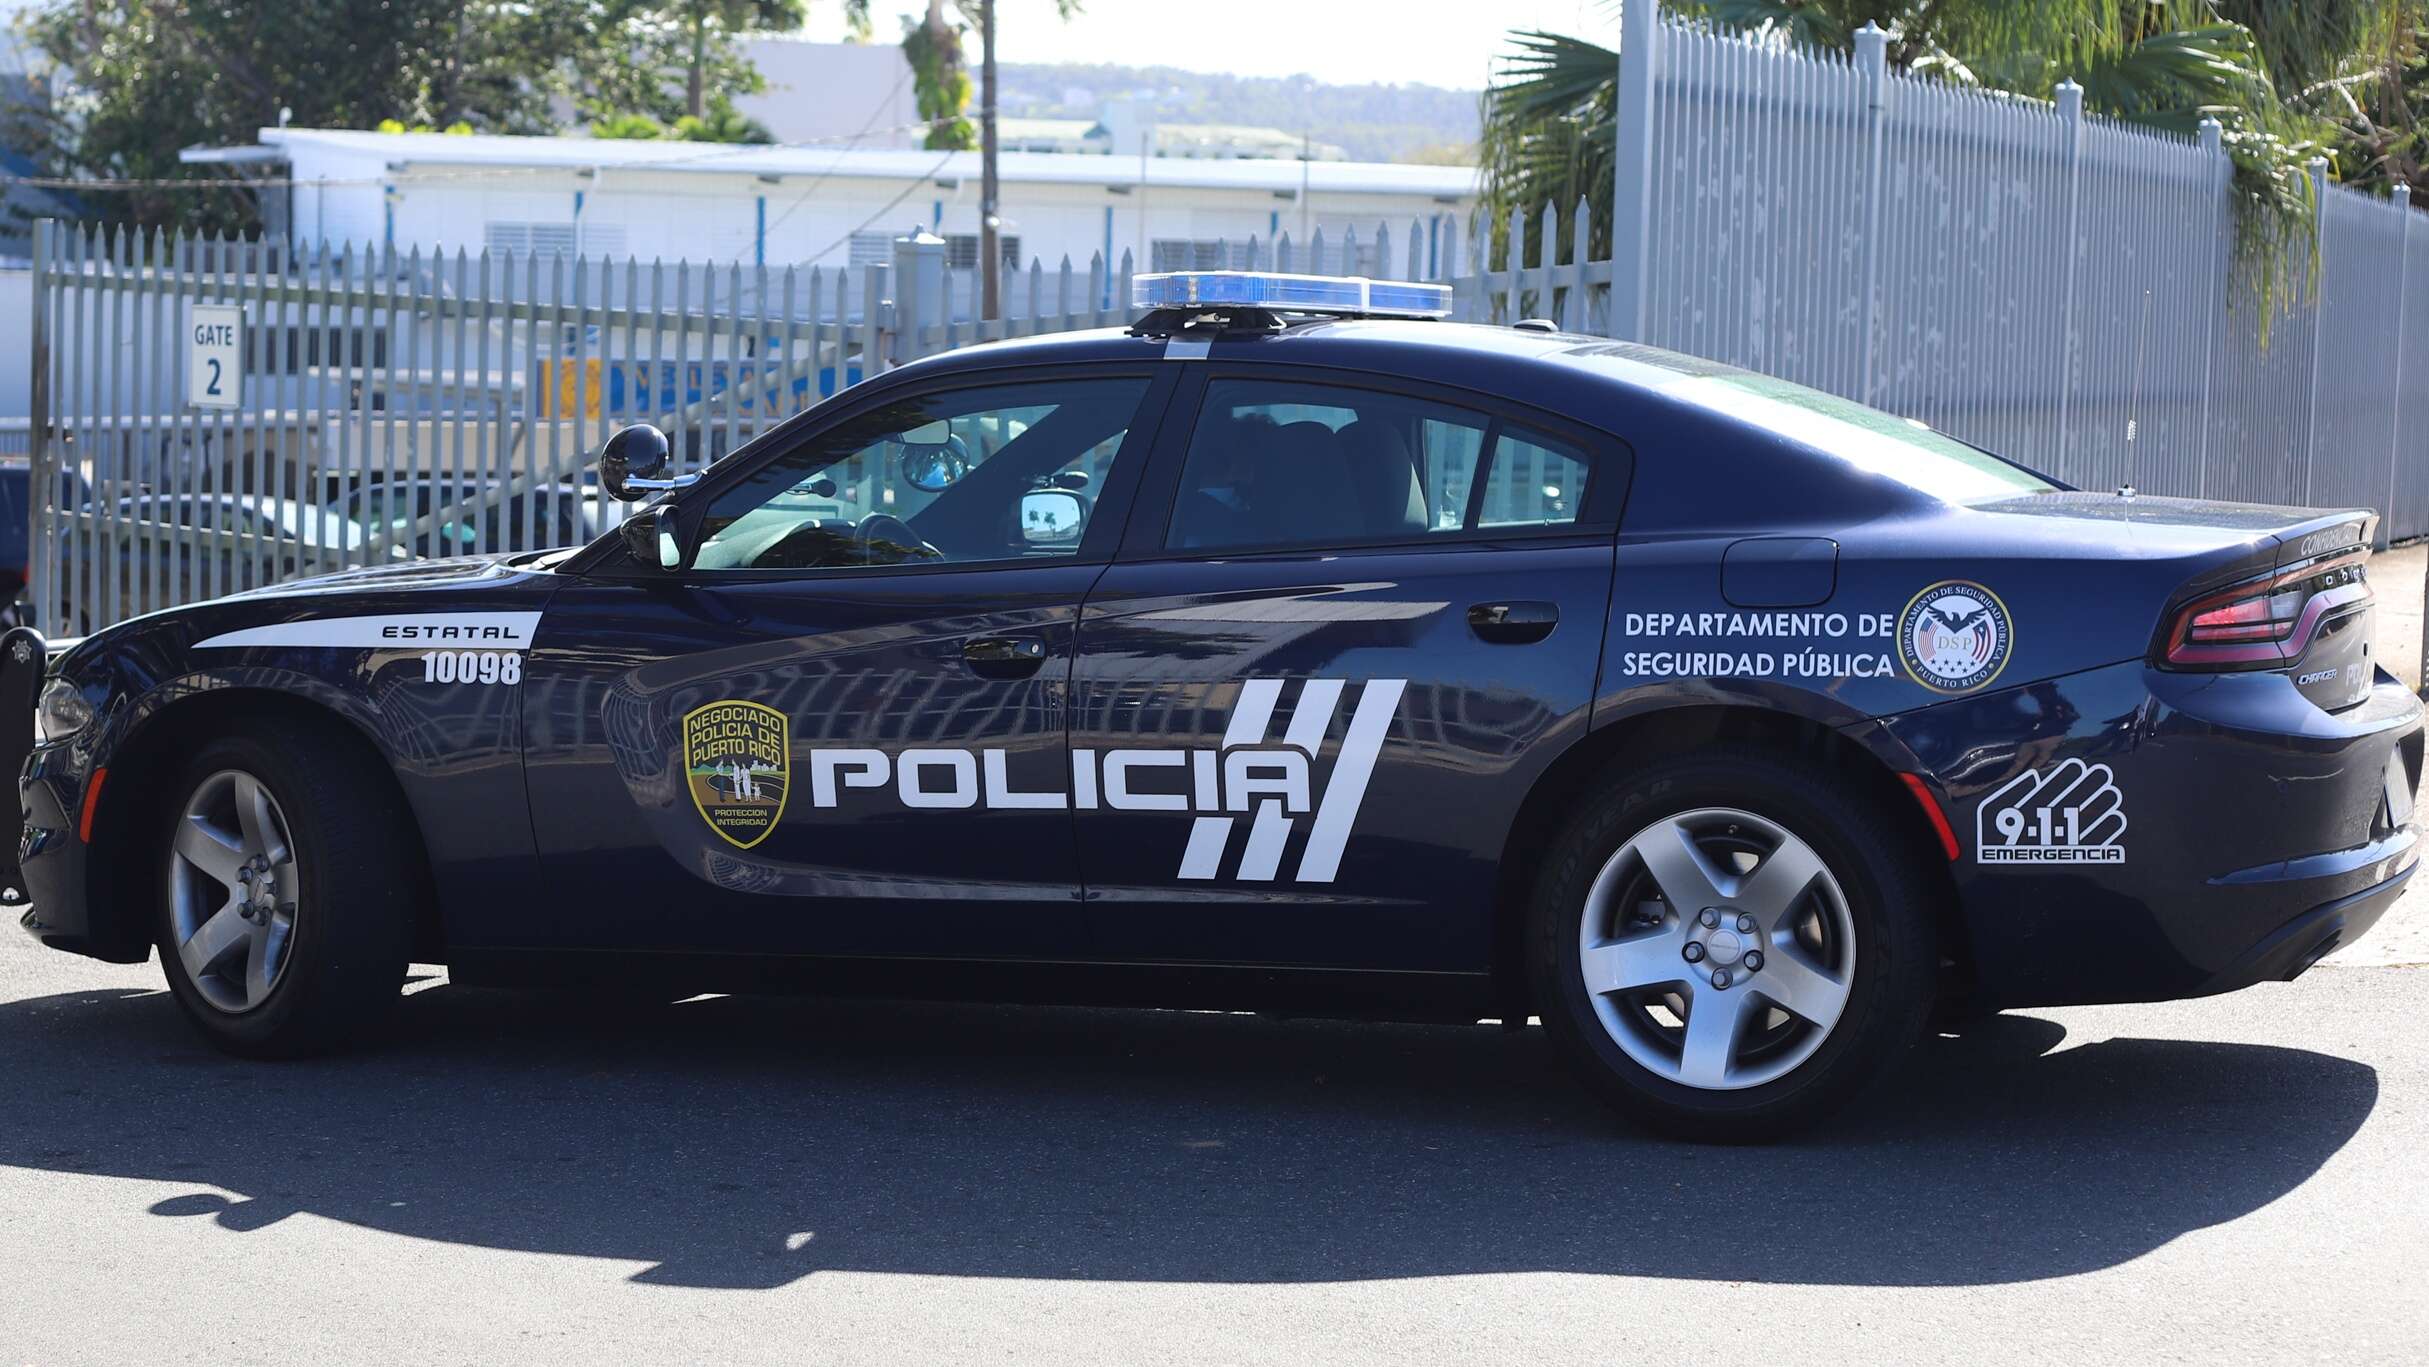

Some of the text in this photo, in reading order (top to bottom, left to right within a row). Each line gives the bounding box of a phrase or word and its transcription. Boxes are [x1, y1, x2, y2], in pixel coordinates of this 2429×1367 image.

[195, 324, 233, 347] GATE
[206, 357, 222, 396] 2
[382, 626, 520, 639] ESTATAL
[1625, 613, 1894, 637] DEPARTAMENTO DE
[1904, 591, 1939, 658] DEPARTAMENTO
[1940, 586, 1954, 597] DE
[1955, 586, 2002, 620] SEGURIDAD
[1937, 636, 1972, 650] DSP
[421, 651, 522, 685] 10098
[1623, 646, 1896, 678] SEGURIDAD PÚBLICA
[1916, 664, 1988, 688] PUERTO RICO
[2297, 668, 2338, 686] CHARGER
[690, 707, 781, 734] NEGOCIADO
[691, 722, 781, 750] POLICIA DE
[693, 738, 781, 767] PUERTO RICO
[810, 748, 1311, 812] POLICIA
[714, 809, 768, 817] PROTECCION
[717, 818, 768, 827] INTEGRIDAD
